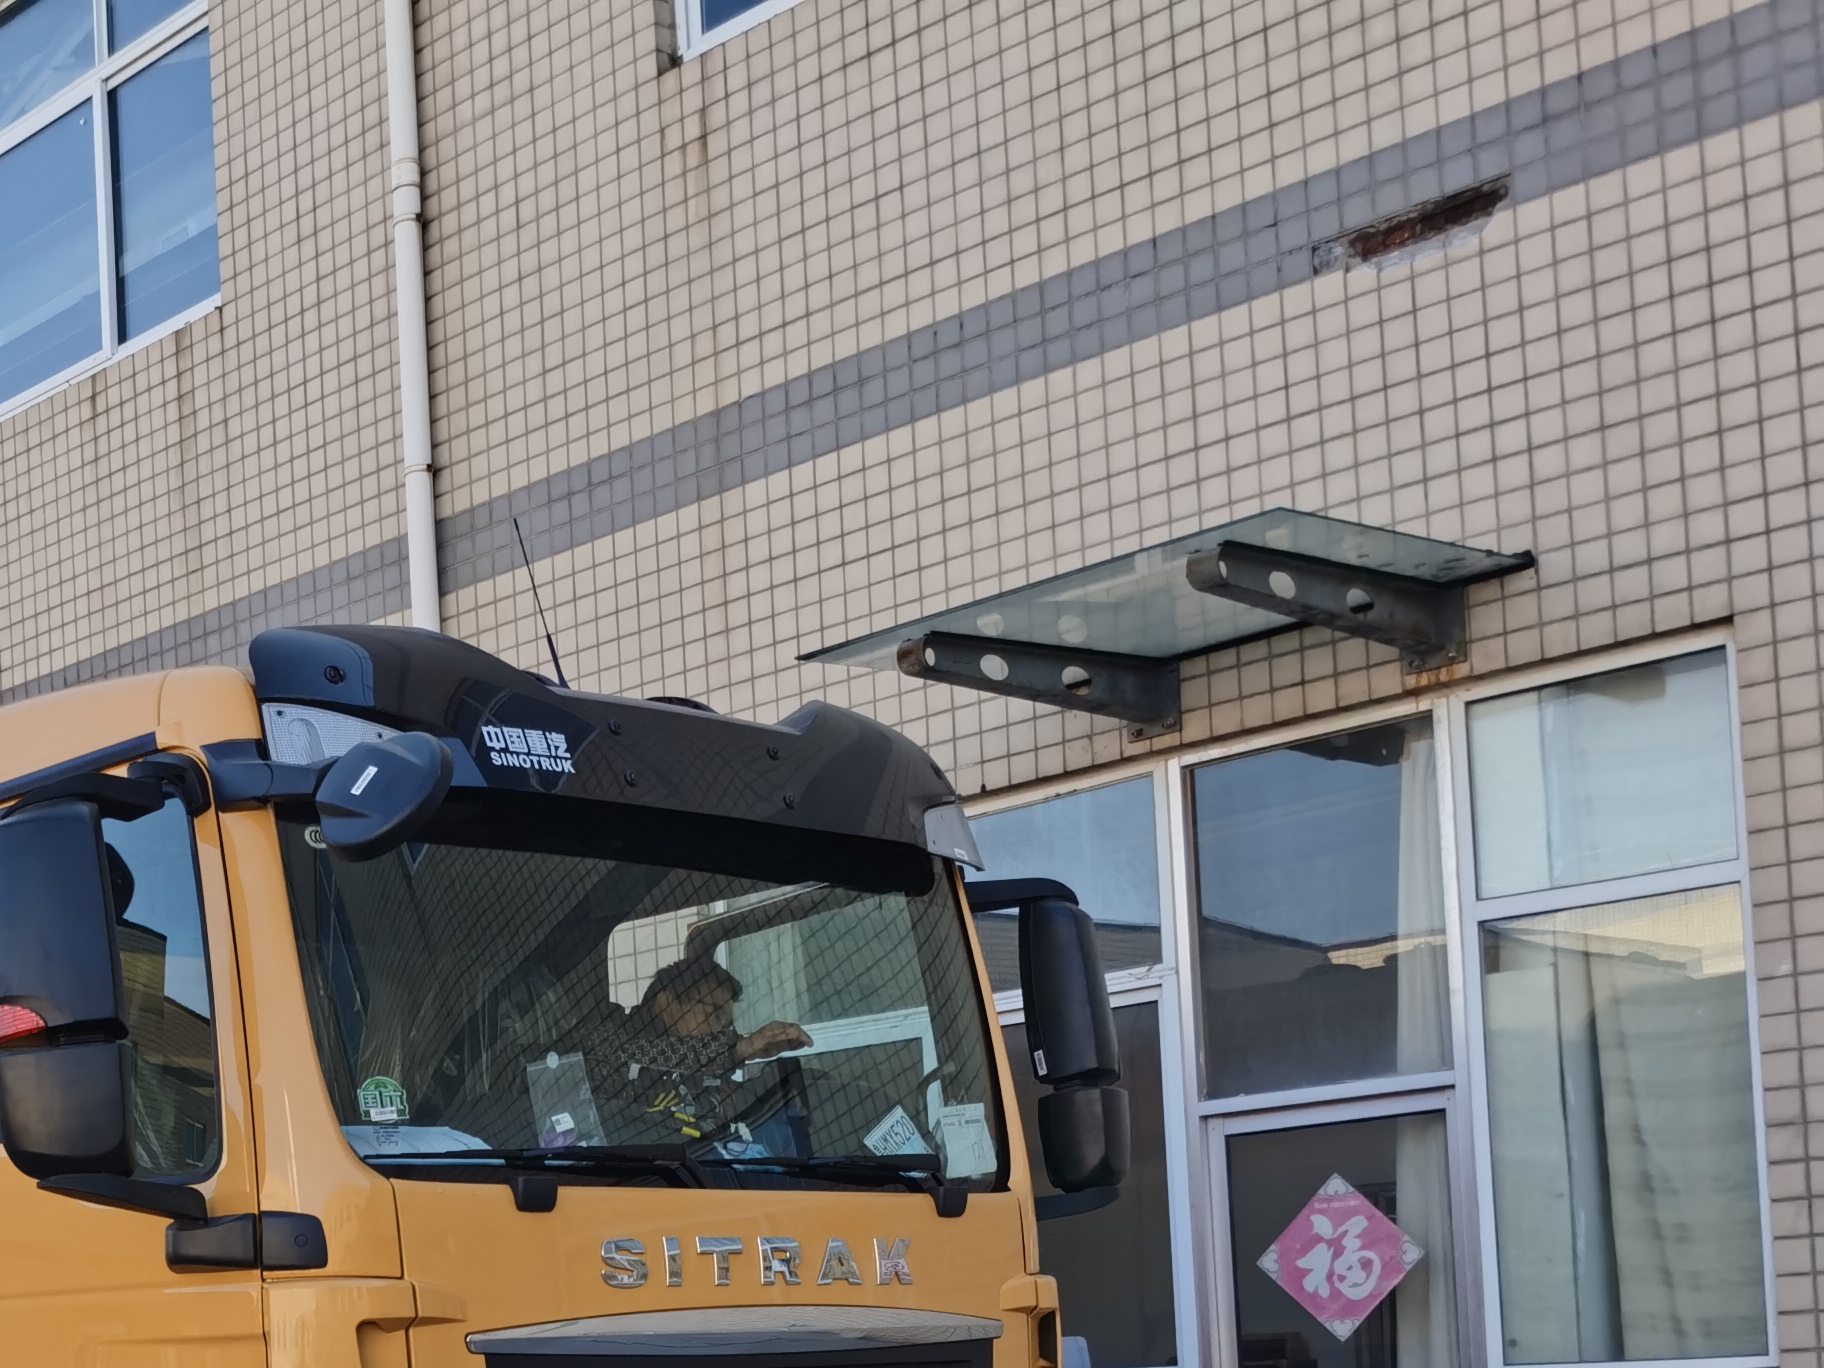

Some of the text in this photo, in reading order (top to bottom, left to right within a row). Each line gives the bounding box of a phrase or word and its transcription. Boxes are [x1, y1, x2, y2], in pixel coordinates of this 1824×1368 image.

[481, 725, 571, 758] 中国重汽
[490, 752, 576, 773] SINOTRUK
[601, 1236, 914, 1289] SITRAK
[1296, 1213, 1382, 1300] 福
